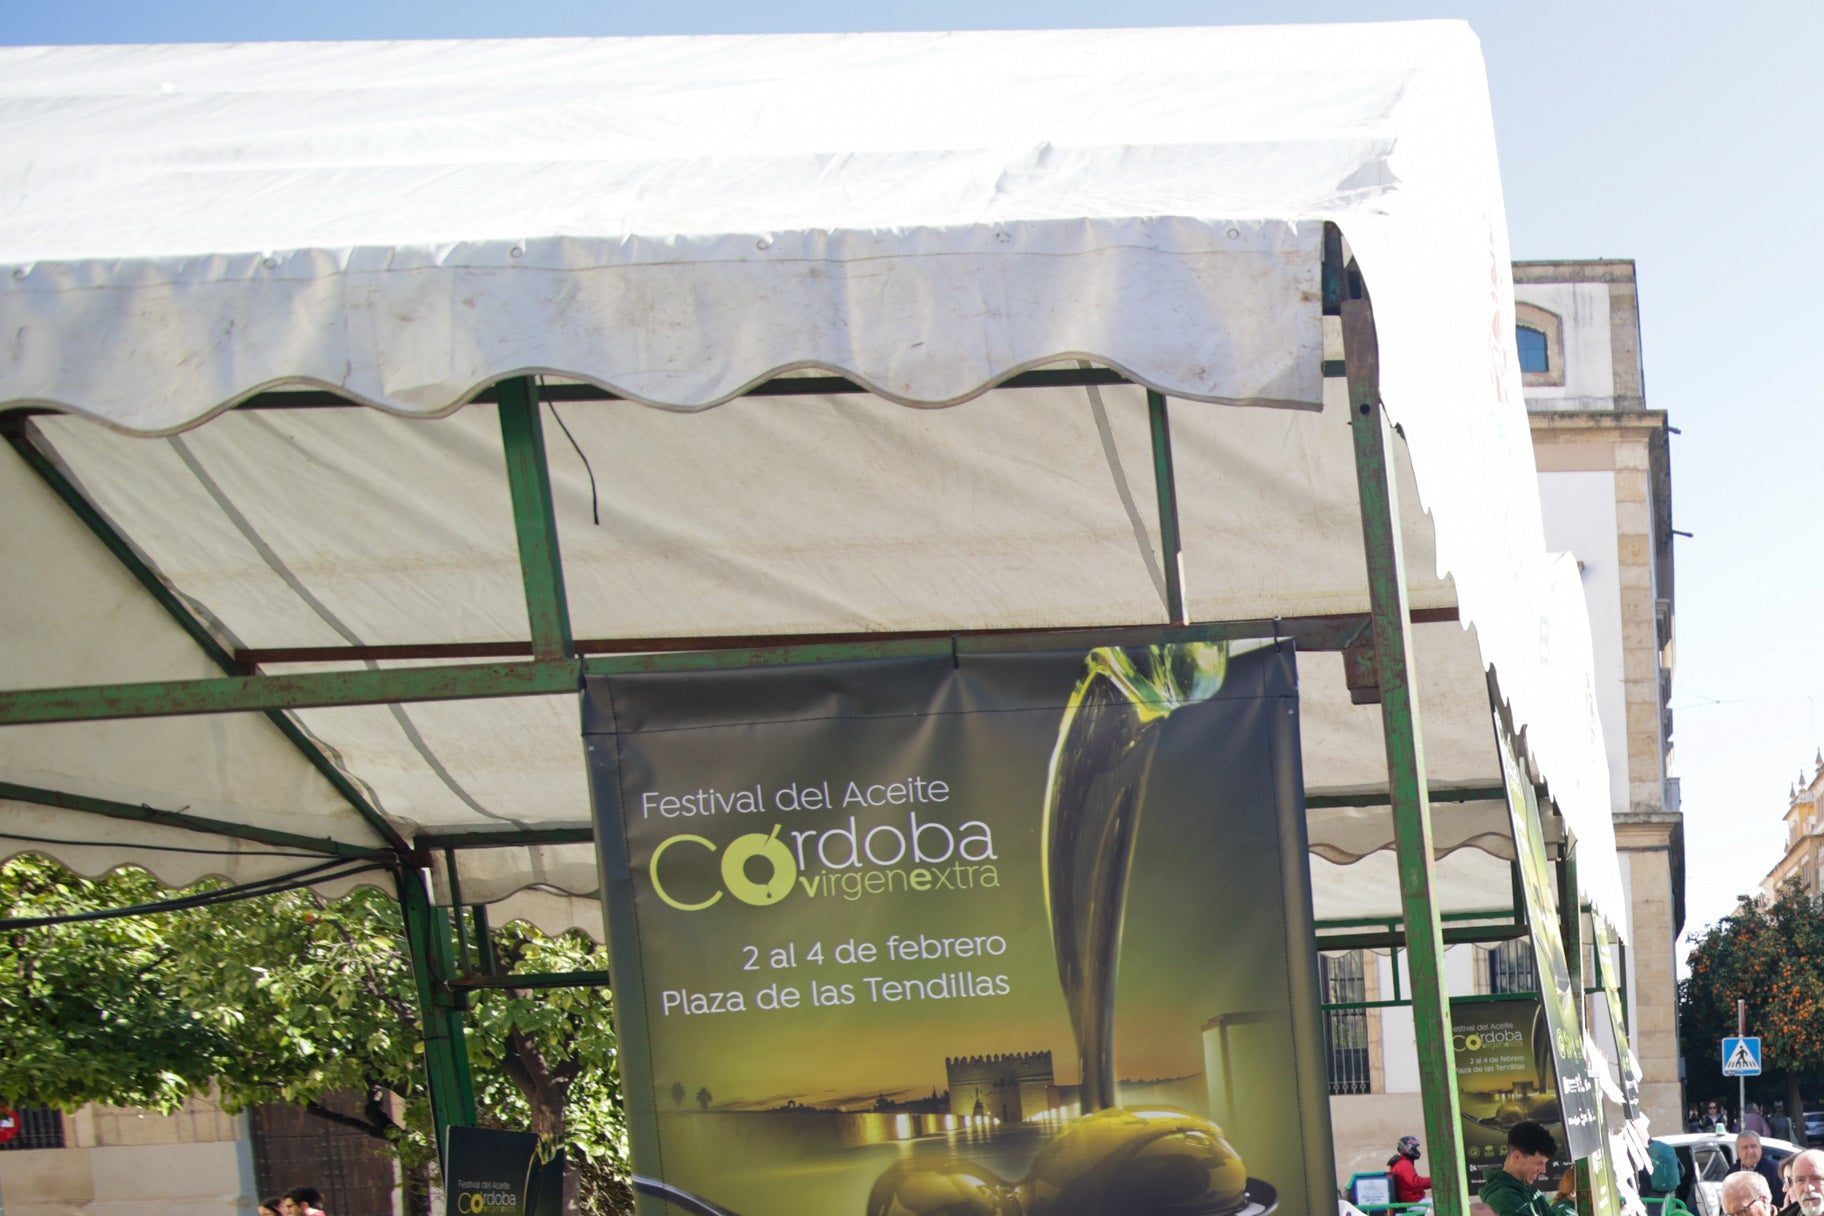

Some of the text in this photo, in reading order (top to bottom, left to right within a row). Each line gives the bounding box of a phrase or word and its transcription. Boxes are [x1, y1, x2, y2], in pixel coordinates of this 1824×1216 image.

[641, 776, 951, 819] Festival del Aceite
[650, 811, 998, 912] Córdoba
[798, 861, 1000, 902] virgenextra
[742, 932, 1007, 971] 2 al 4 de febrero
[662, 967, 1010, 1017] Plaza de las Tendillas
